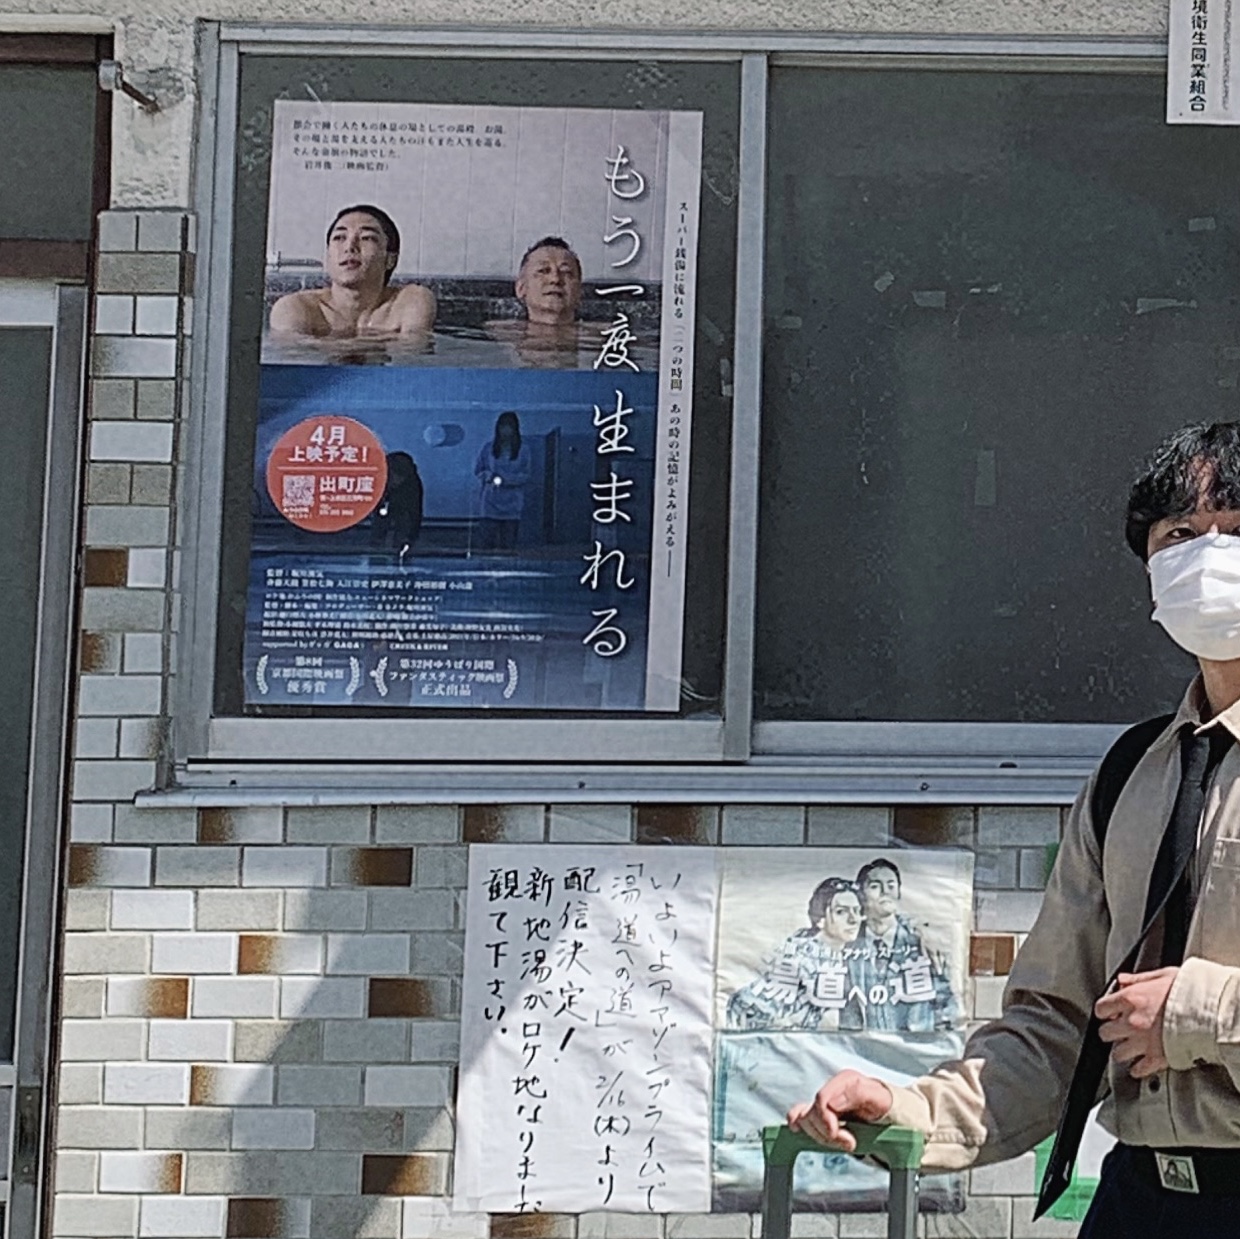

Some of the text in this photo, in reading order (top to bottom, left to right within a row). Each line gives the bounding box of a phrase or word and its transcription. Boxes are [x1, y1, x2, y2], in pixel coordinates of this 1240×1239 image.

[579, 143, 647, 657] もう一度生まれる
[310, 425, 346, 446] 4月
[319, 475, 375, 493] 出町座
